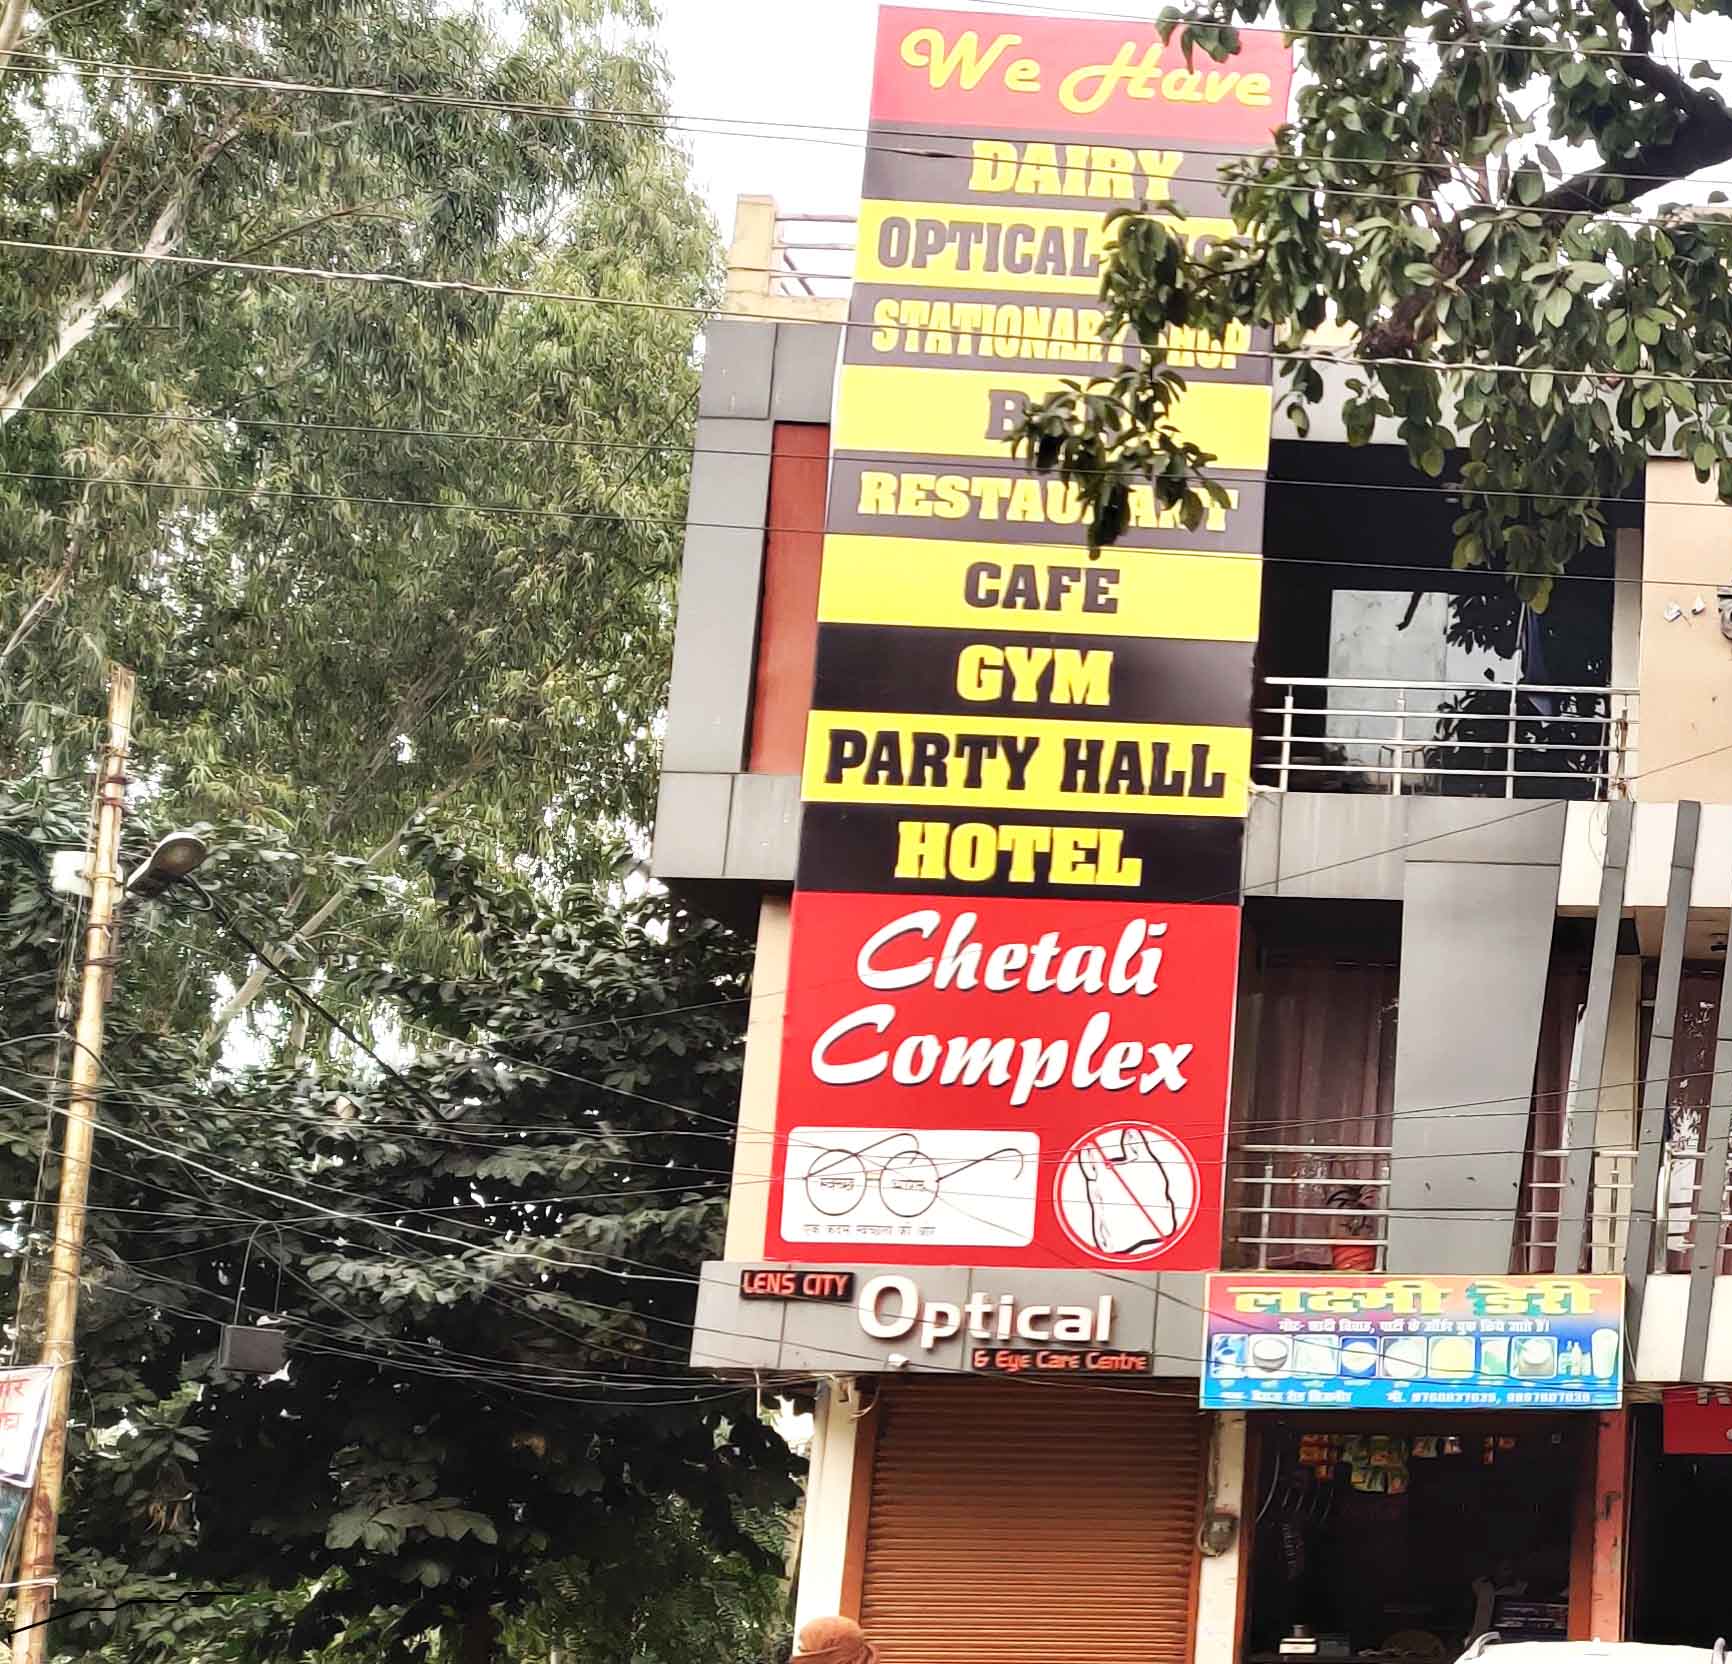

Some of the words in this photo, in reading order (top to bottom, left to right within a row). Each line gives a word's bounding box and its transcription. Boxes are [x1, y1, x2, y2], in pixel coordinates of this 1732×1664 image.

[901, 28, 1042, 91] We
[1059, 41, 1273, 113] Have
[969, 140, 1184, 201] DAIRY
[878, 216, 1102, 277] OPTICAL
[858, 471, 1240, 532] RESTAUAT
[964, 562, 1121, 614] CAFE
[956, 644, 1115, 706] GYM
[824, 729, 1040, 791] PARTY
[1059, 737, 1226, 799] HALL
[894, 820, 1143, 887] HOTEL
[857, 909, 1169, 997] Chetali
[811, 1004, 1193, 1106] Complex
[742, 1272, 796, 1296] LENS
[802, 1273, 849, 1298] CITY
[857, 1275, 1114, 1349] Optical
[973, 1350, 988, 1370] &
[994, 1350, 1032, 1372] Eye
[1036, 1351, 1080, 1371] Care
[1085, 1352, 1147, 1372] Centre
